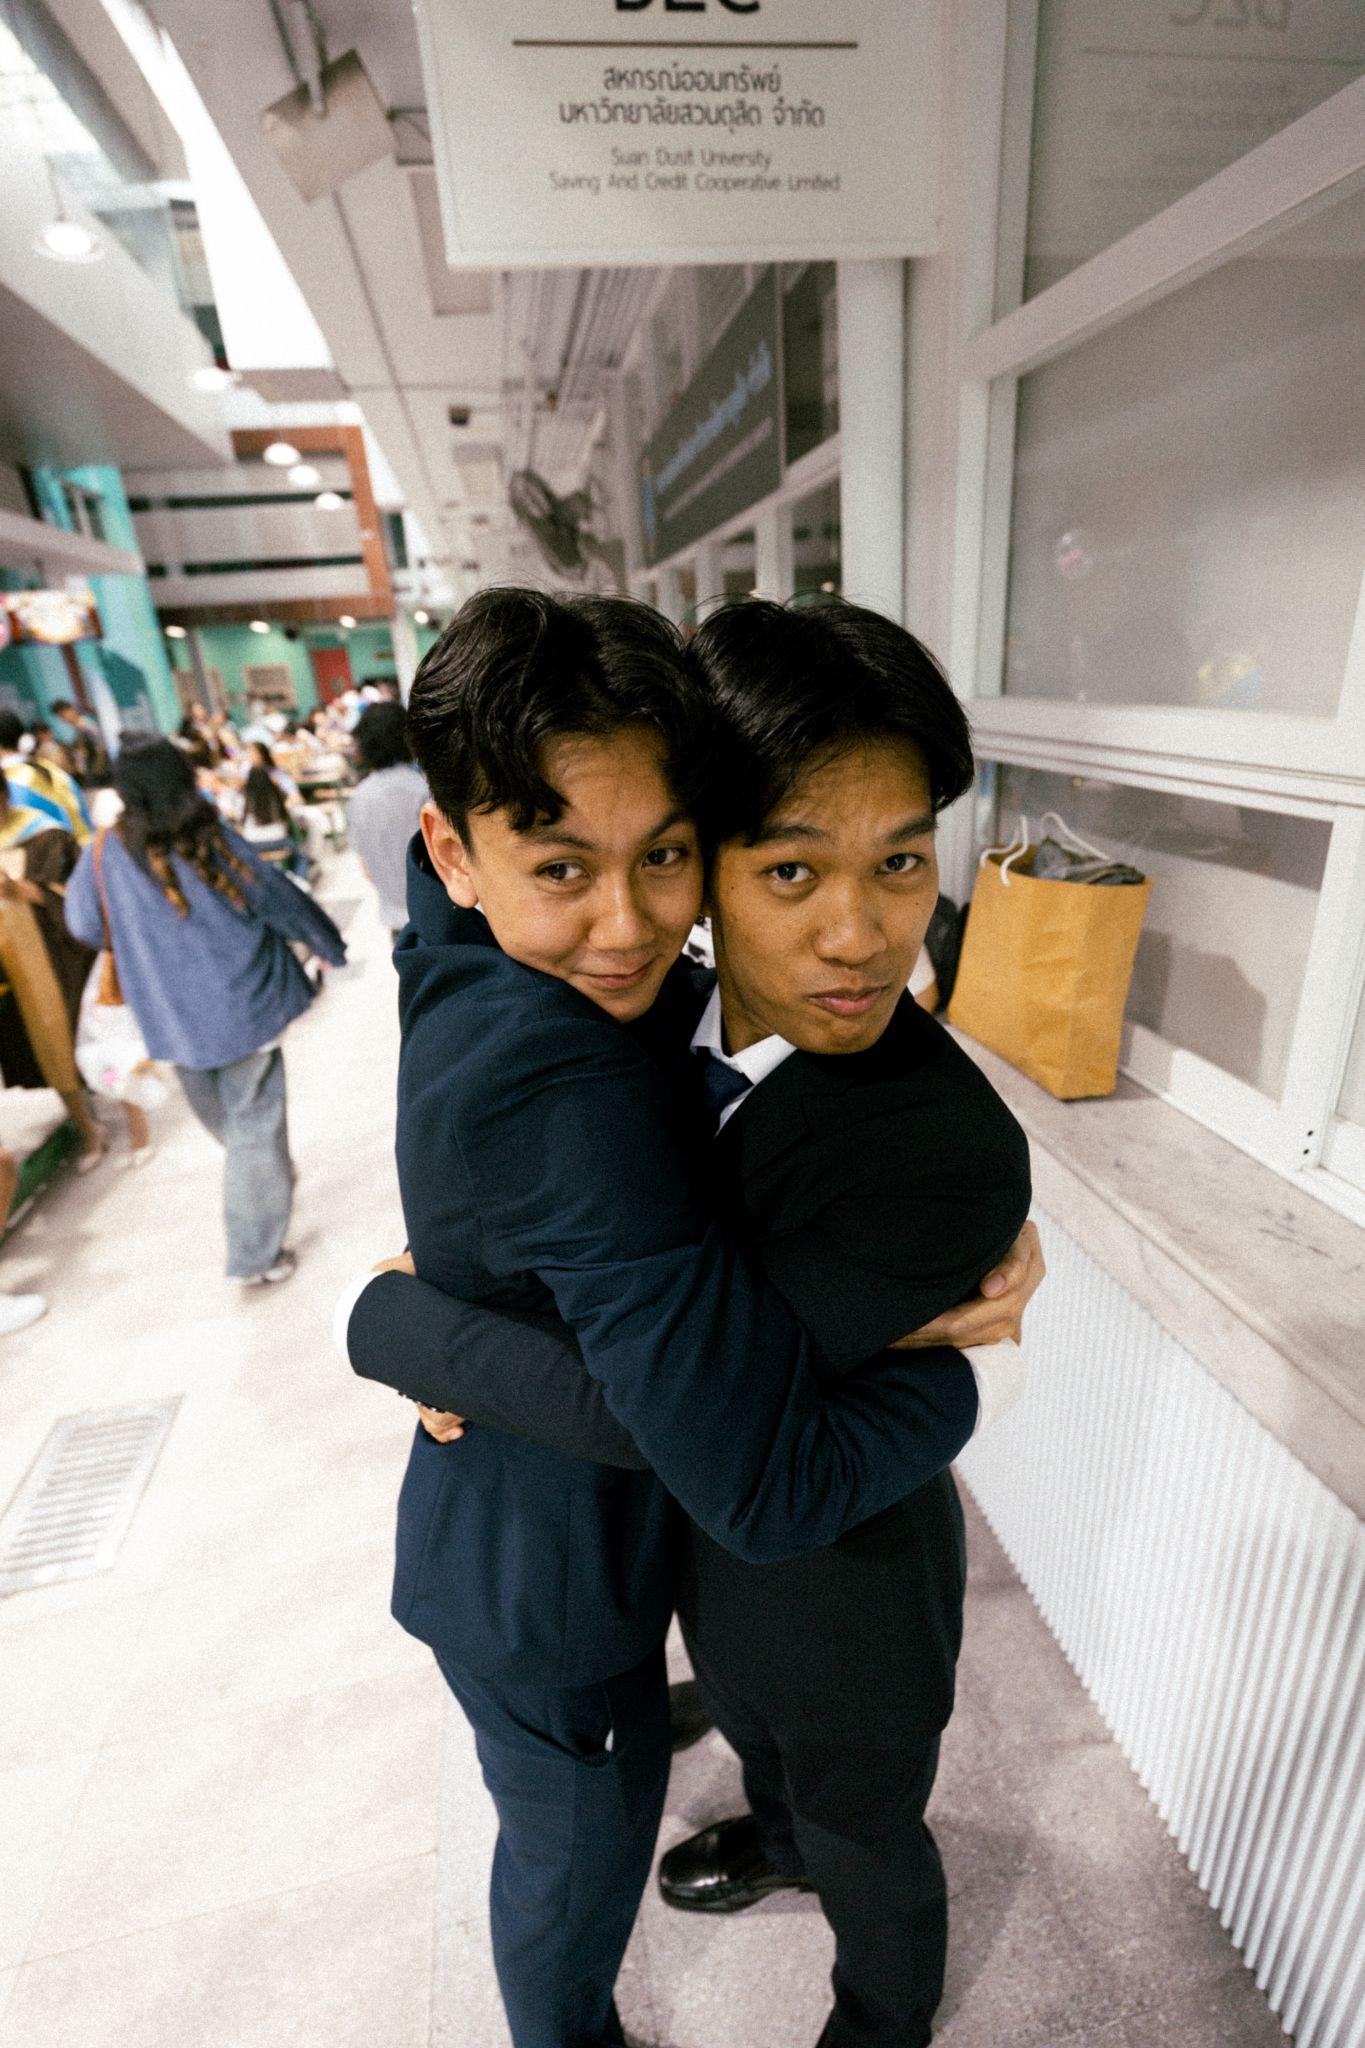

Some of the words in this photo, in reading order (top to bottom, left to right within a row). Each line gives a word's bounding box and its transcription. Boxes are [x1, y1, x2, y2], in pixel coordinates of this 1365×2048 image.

[603, 61, 782, 93] สหกรณ์ออมทรัพย์
[772, 95, 825, 128] จำกัด
[611, 146, 648, 166] Suan
[655, 146, 694, 167] Dusit
[701, 148, 771, 171] University
[548, 171, 601, 194] Saving
[608, 171, 639, 190] And
[645, 171, 688, 191] Credit
[695, 171, 781, 194] Cooperative
[787, 172, 842, 192] Limited
